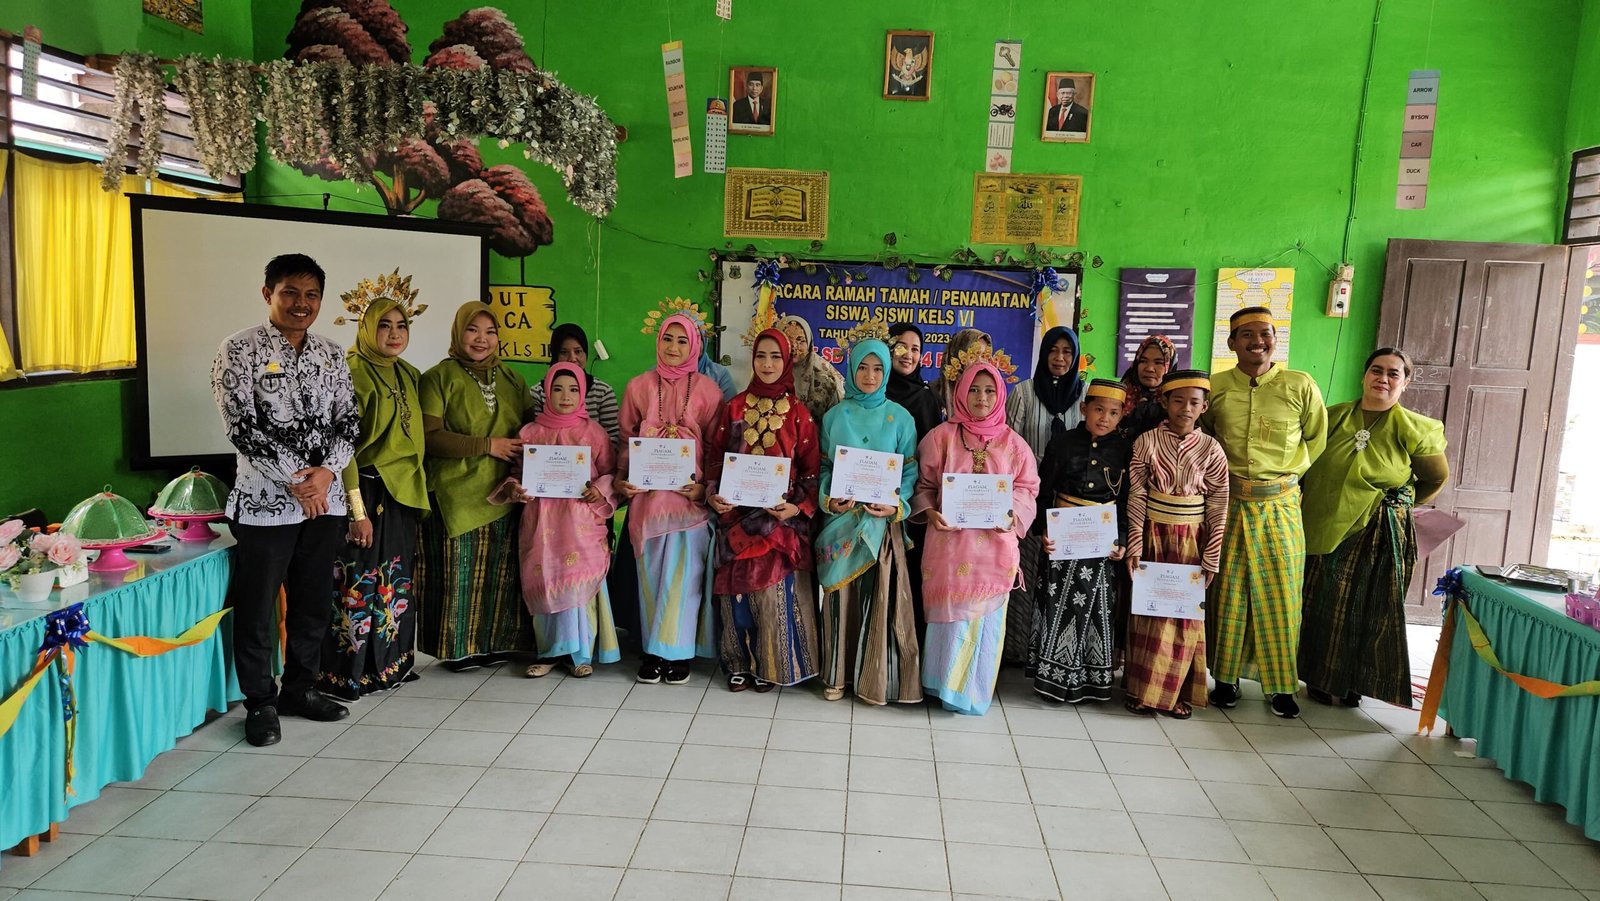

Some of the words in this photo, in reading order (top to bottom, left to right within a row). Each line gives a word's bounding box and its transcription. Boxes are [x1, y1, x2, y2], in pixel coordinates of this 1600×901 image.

[776, 284, 822, 300] ACARA
[826, 285, 876, 302] RAMAH
[880, 287, 930, 305] TAMAH
[933, 289, 938, 305] /
[942, 290, 1030, 309] PENAMATAN
[826, 304, 870, 321] SISWA
[874, 306, 914, 324] SISWI
[918, 308, 955, 326] KELS
[959, 309, 975, 327] VI
